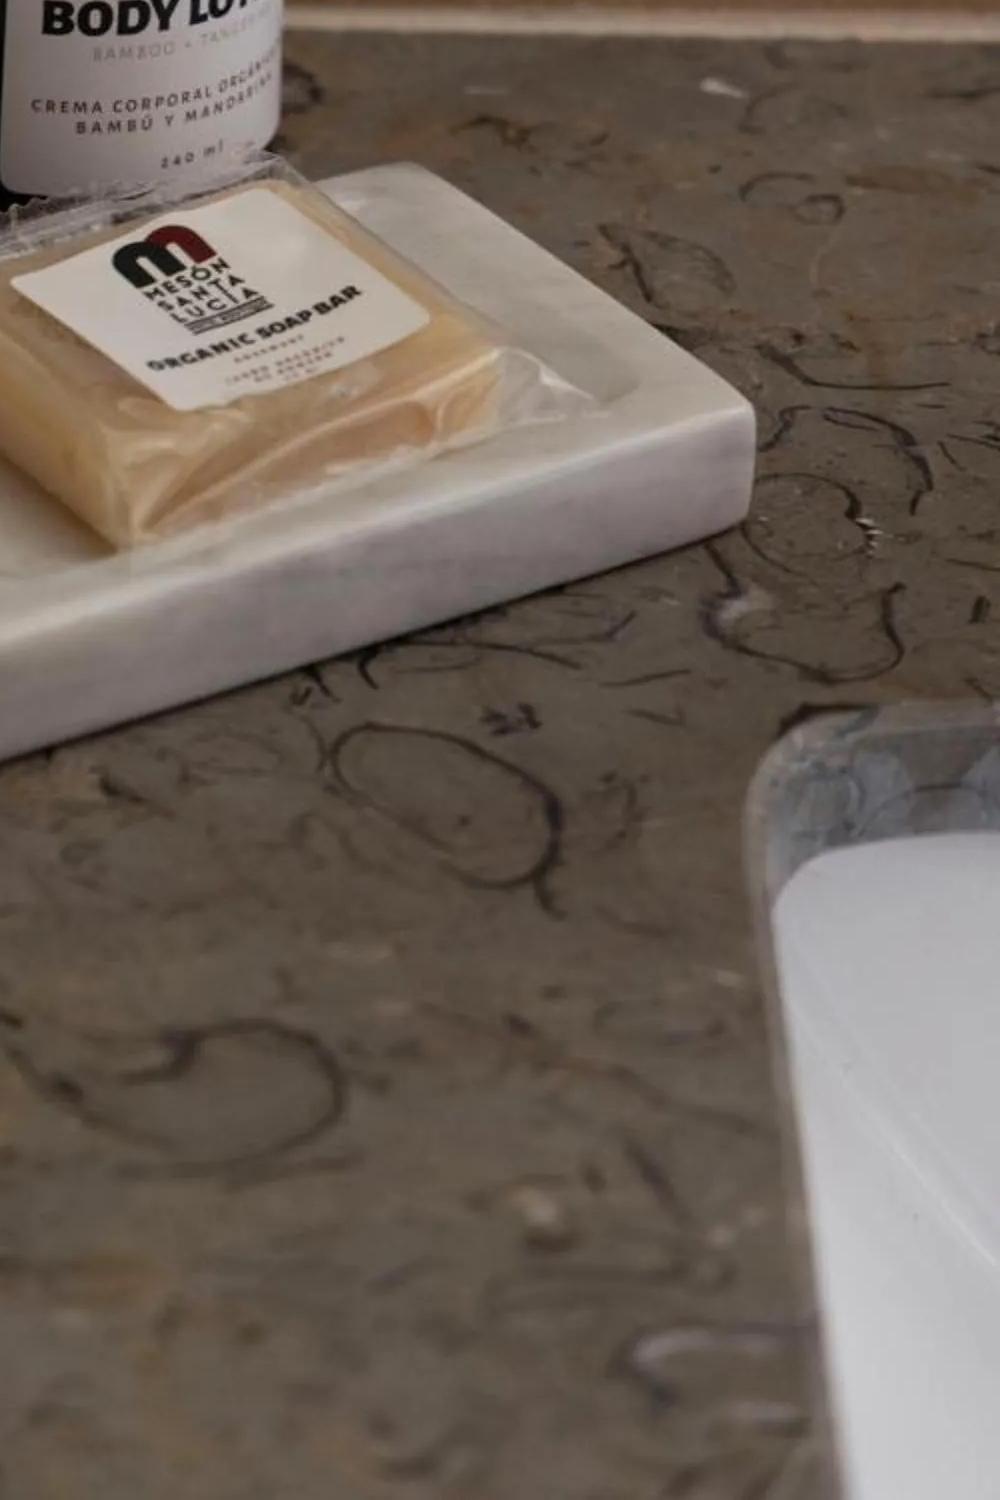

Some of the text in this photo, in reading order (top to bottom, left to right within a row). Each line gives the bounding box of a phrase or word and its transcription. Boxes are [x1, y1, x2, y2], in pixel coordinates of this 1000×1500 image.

[31, 99, 104, 115] CREMA
[112, 85, 212, 114] CORPORAL
[75, 115, 154, 135] BAMBÚ
[164, 115, 174, 128] Y
[160, 140, 224, 169] 240 ml
[142, 257, 231, 301] MESÓN
[156, 274, 246, 312] SANTA
[146, 333, 256, 371] ORGANIC
[255, 309, 313, 339] SOAP
[312, 284, 363, 316] BAR
